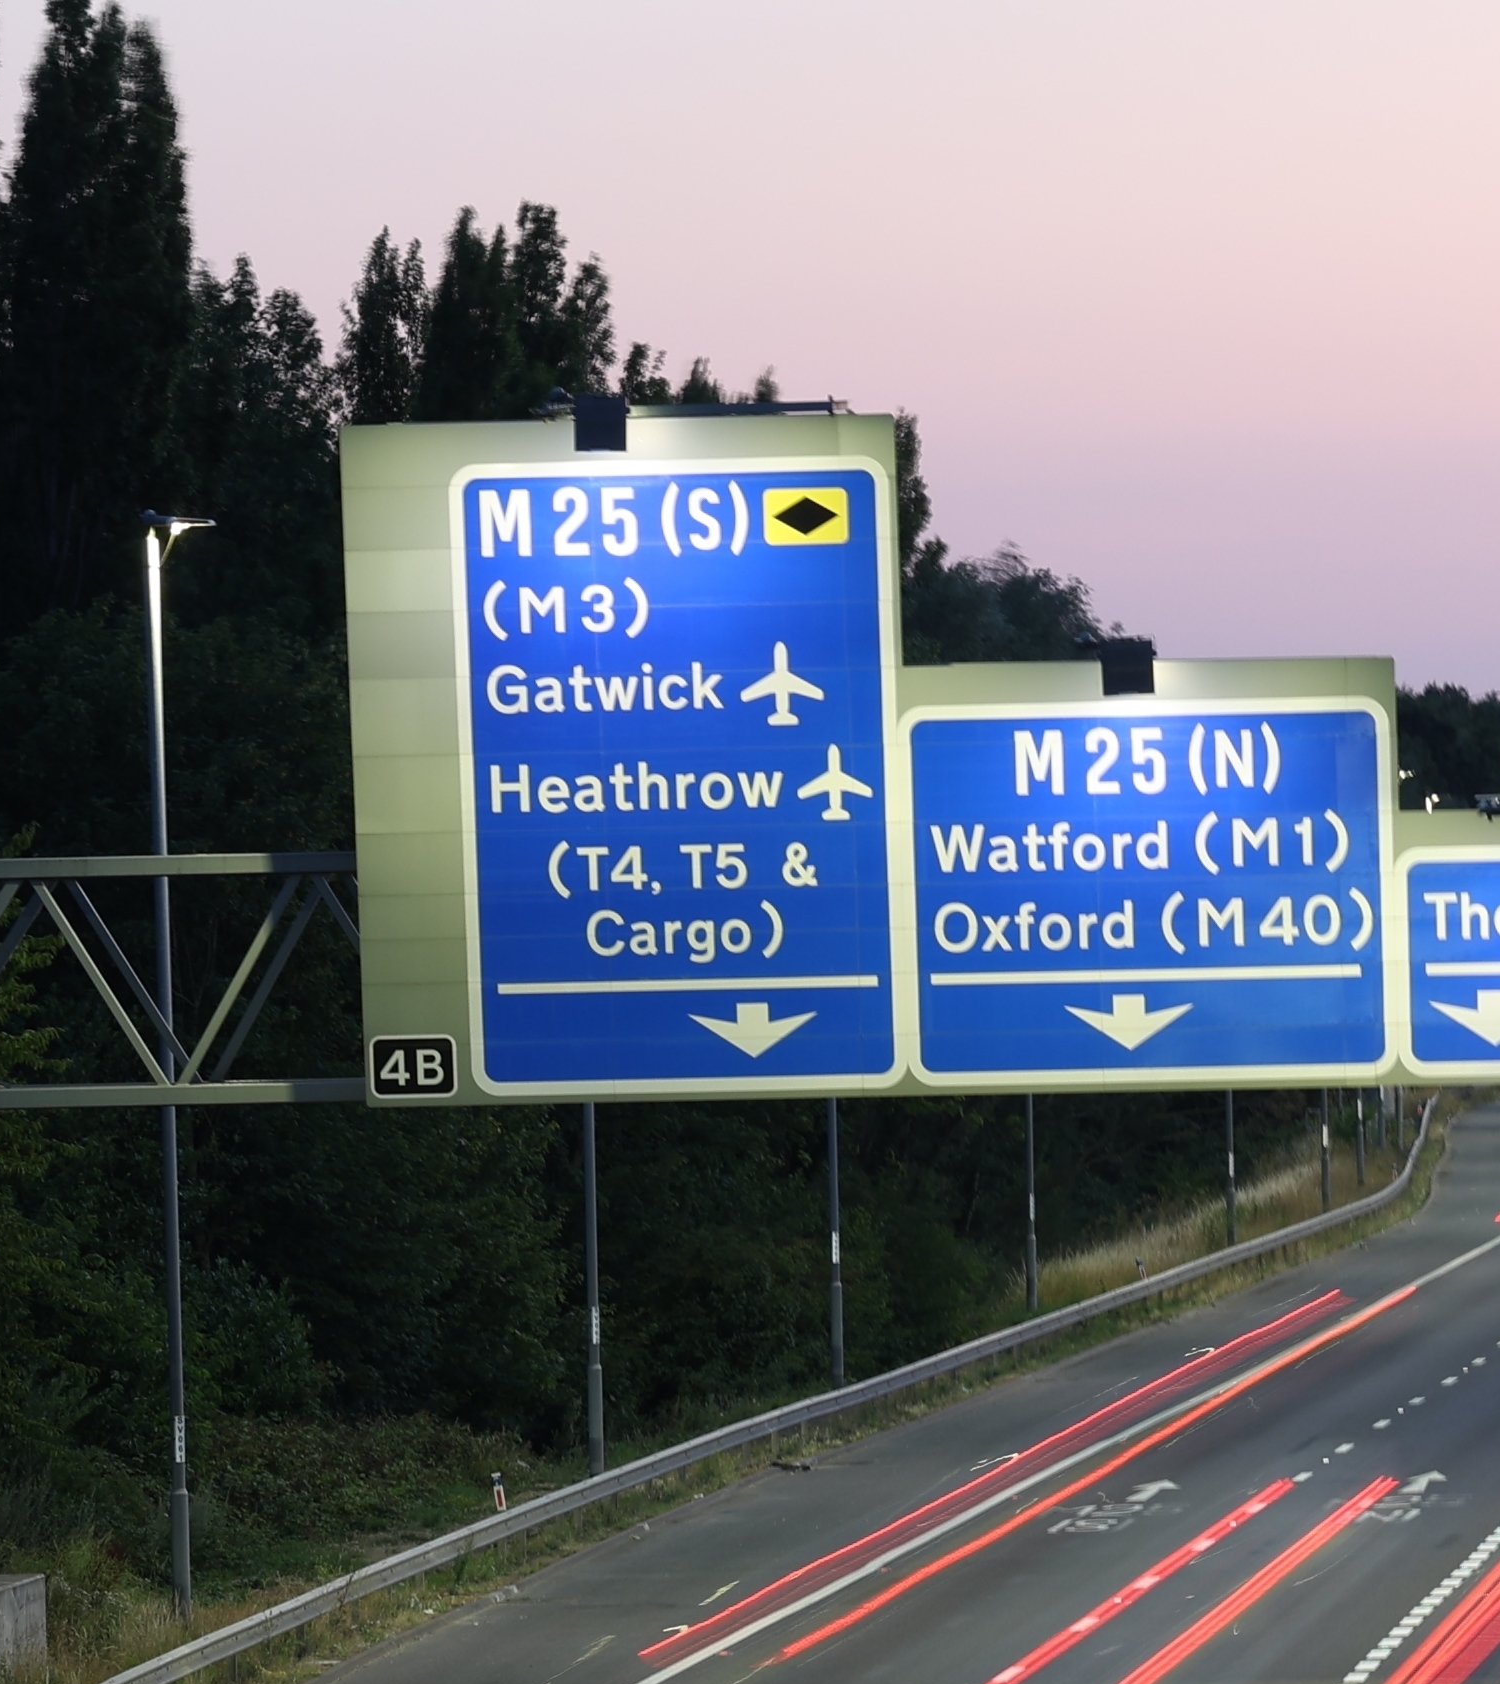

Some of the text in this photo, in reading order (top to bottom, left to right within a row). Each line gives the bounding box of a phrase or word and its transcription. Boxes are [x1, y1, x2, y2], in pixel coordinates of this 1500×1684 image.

[483, 577, 649, 640] (M3)
[487, 662, 723, 714] Gatwick
[491, 762, 783, 813] Heathrow
[549, 841, 817, 898] (T4, T5 &
[931, 809, 1349, 875] Watford (M1)
[587, 901, 783, 962] Cargo)
[935, 887, 1373, 954] Oxford (M40)
[379, 1050, 444, 1086] 4B
